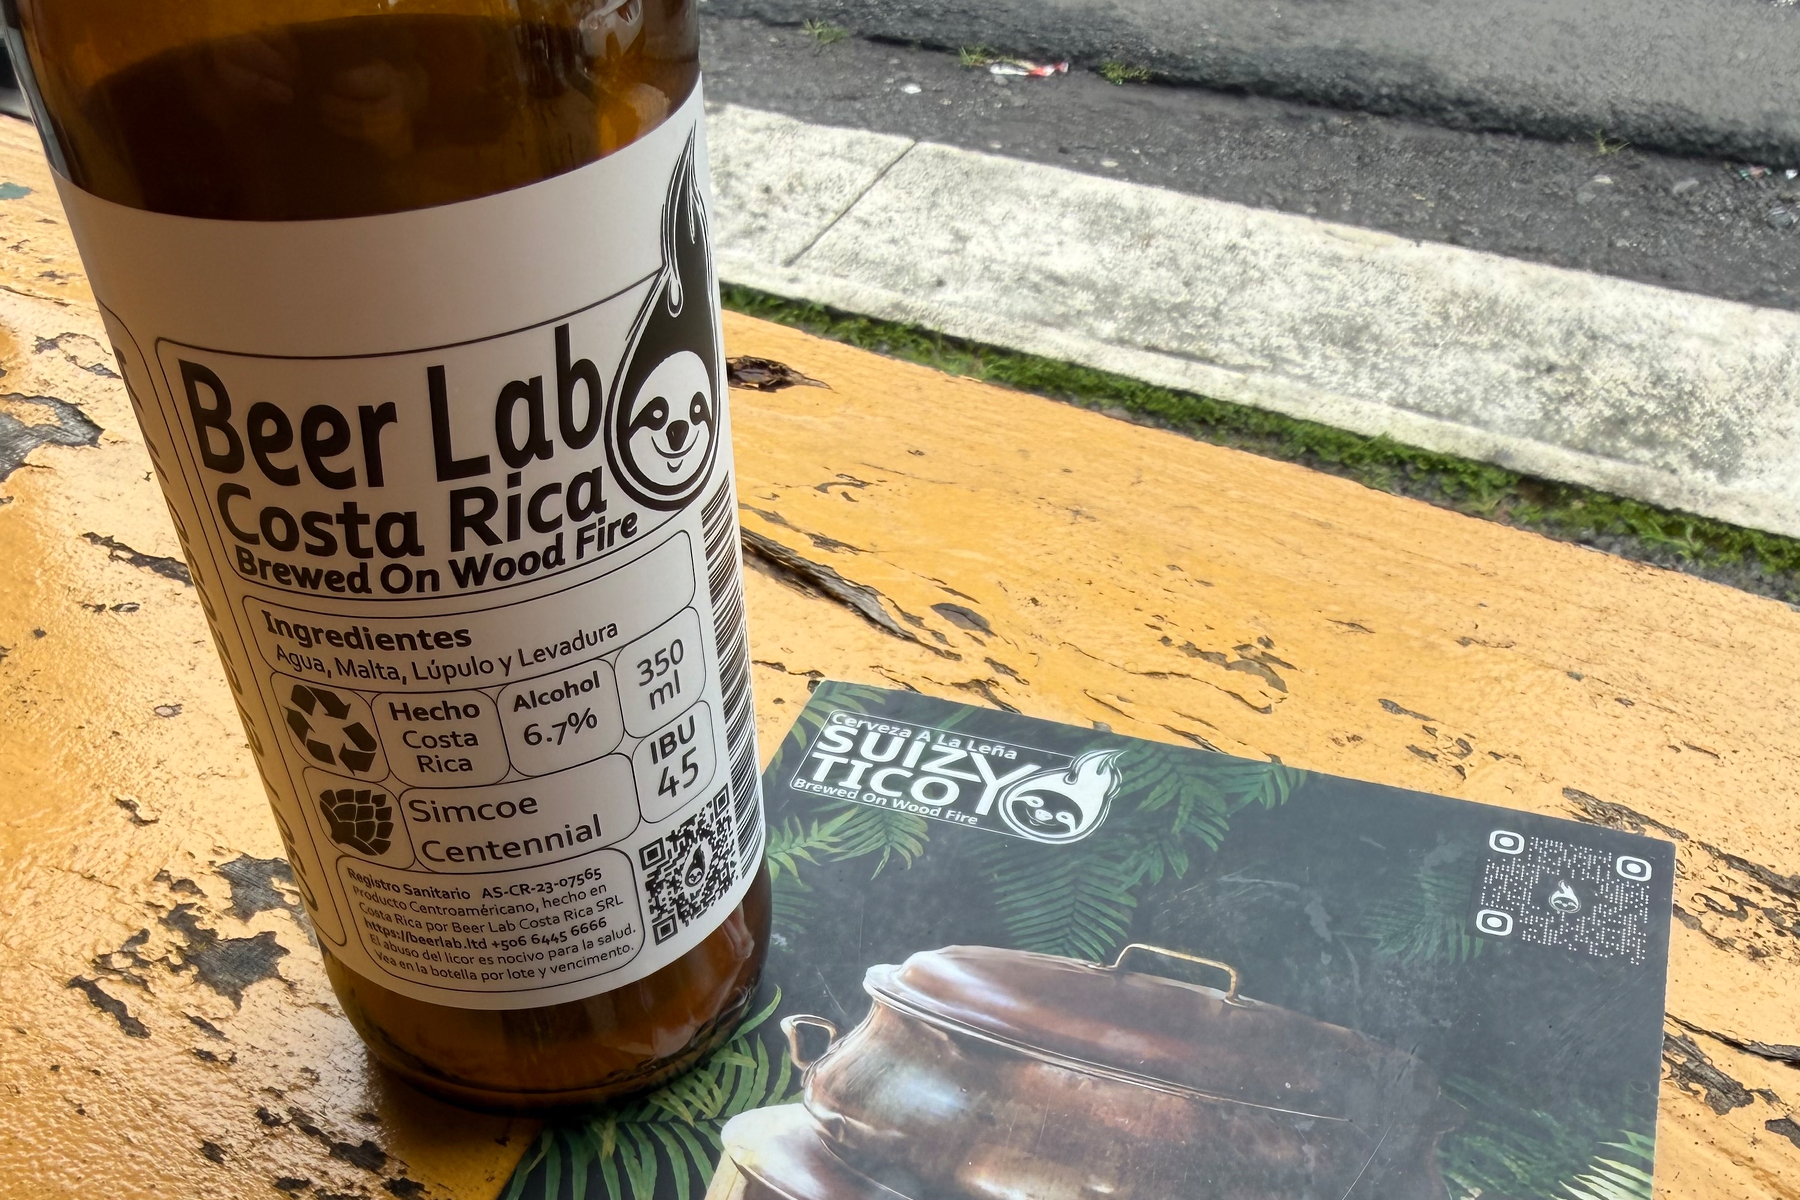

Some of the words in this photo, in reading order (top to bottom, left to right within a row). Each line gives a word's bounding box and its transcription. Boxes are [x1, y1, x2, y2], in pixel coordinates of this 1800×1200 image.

[178, 358, 397, 490] Beer
[427, 323, 602, 482] Lab
[217, 483, 424, 558] Costa
[450, 466, 607, 552] Rica
[235, 544, 372, 594] Brewed
[380, 563, 440, 594] On
[448, 532, 565, 588] Wood
[576, 512, 638, 560] Fire
[261, 609, 472, 651] Ingredientes
[276, 644, 332, 679] Agua,
[334, 657, 407, 685] Malta,
[411, 656, 494, 685] Lúpulo
[498, 656, 512, 677] y
[518, 622, 618, 667] Levadura
[636, 638, 684, 687] 350
[388, 700, 480, 721] Hecho
[513, 670, 600, 712] Alcohol
[649, 669, 681, 710] ml
[402, 730, 479, 749] Costa
[523, 707, 598, 745] 6.7%
[650, 714, 696, 765] IBU
[831, 713, 912, 738] Cerveza
[915, 730, 931, 742] A
[936, 734, 962, 748] La
[966, 739, 1018, 760] Leña
[416, 754, 474, 773] Rica
[657, 746, 699, 798] 45
[408, 796, 539, 823] Simcoe
[793, 778, 859, 800] Brewed
[862, 792, 887, 806] On
[892, 798, 942, 817] Wood
[945, 809, 979, 825] Fire
[421, 813, 602, 863] Centennial
[346, 867, 401, 894] Registro
[403, 883, 471, 900] Sanitario
[482, 867, 602, 899] AS-CR-23-07565
[409, 901, 539, 917] Centroaméricano,
[542, 890, 587, 909] hecho
[590, 883, 607, 897] en
[359, 902, 393, 923] Costa
[394, 913, 422, 929] Rica
[426, 921, 448, 933] por
[451, 922, 485, 933] Beer
[488, 920, 516, 933] Lab
[519, 915, 560, 930] Costa
[564, 906, 594, 922] Rica
[596, 895, 624, 913] SRL
[363, 916, 488, 950] https://beerlab.ltd
[491, 935, 527, 951] +506
[531, 930, 568, 946] 6445
[570, 917, 608, 937] 6666
[369, 933, 381, 947] El
[383, 940, 420, 959] abuso
[422, 949, 442, 962] del
[445, 952, 475, 965] licor
[478, 956, 494, 965] es
[497, 951, 545, 965] nocivo
[548, 943, 579, 961] para
[582, 939, 594, 951] la
[597, 922, 637, 947] salud.
[374, 949, 397, 967] Vea
[399, 960, 414, 972] en
[416, 963, 428, 975] la
[430, 965, 478, 981] botella
[481, 971, 505, 983] por
[507, 968, 535, 980] lote
[538, 967, 547, 979] y
[549, 943, 634, 974] vencimento.
